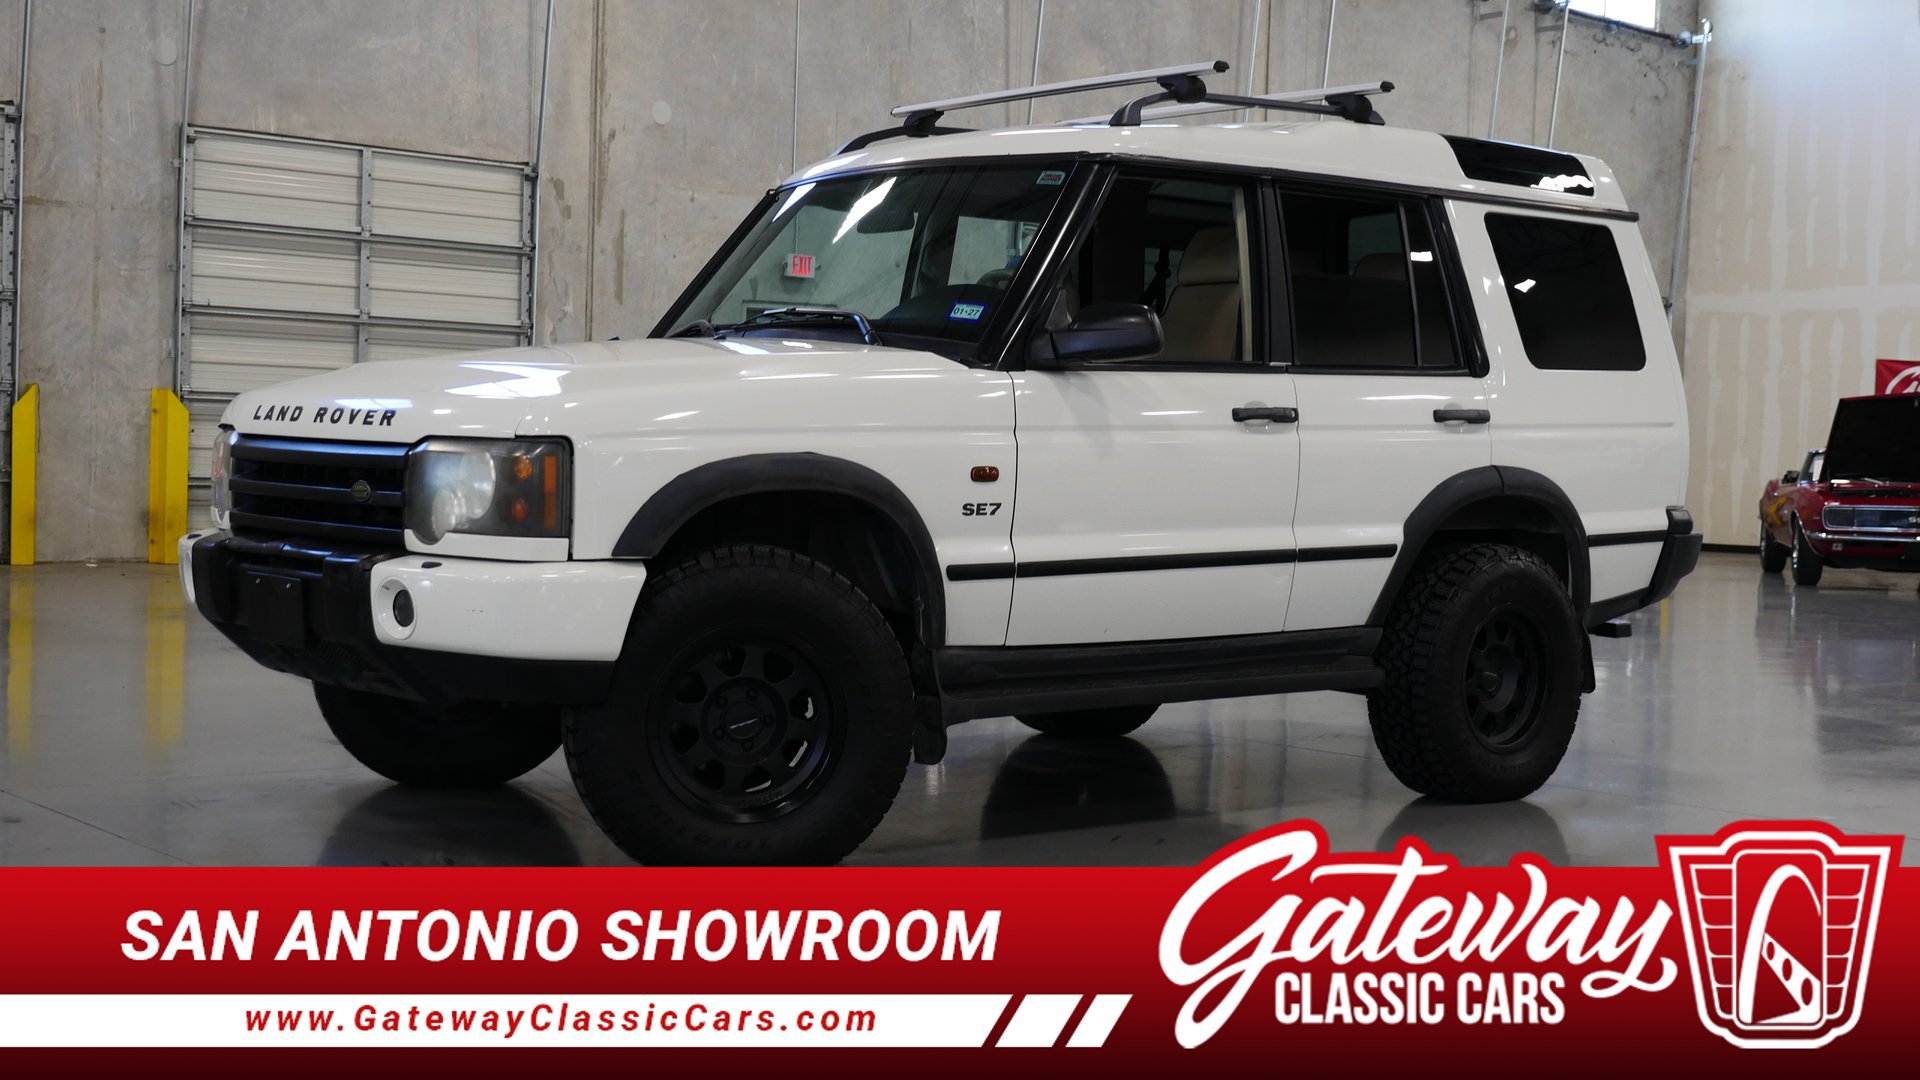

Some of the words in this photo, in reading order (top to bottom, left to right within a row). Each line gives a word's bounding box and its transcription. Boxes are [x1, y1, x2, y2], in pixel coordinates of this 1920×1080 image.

[792, 255, 813, 276] EXIT
[253, 405, 303, 422] LAND
[313, 407, 396, 426] ROVER
[962, 503, 1002, 516] SE7
